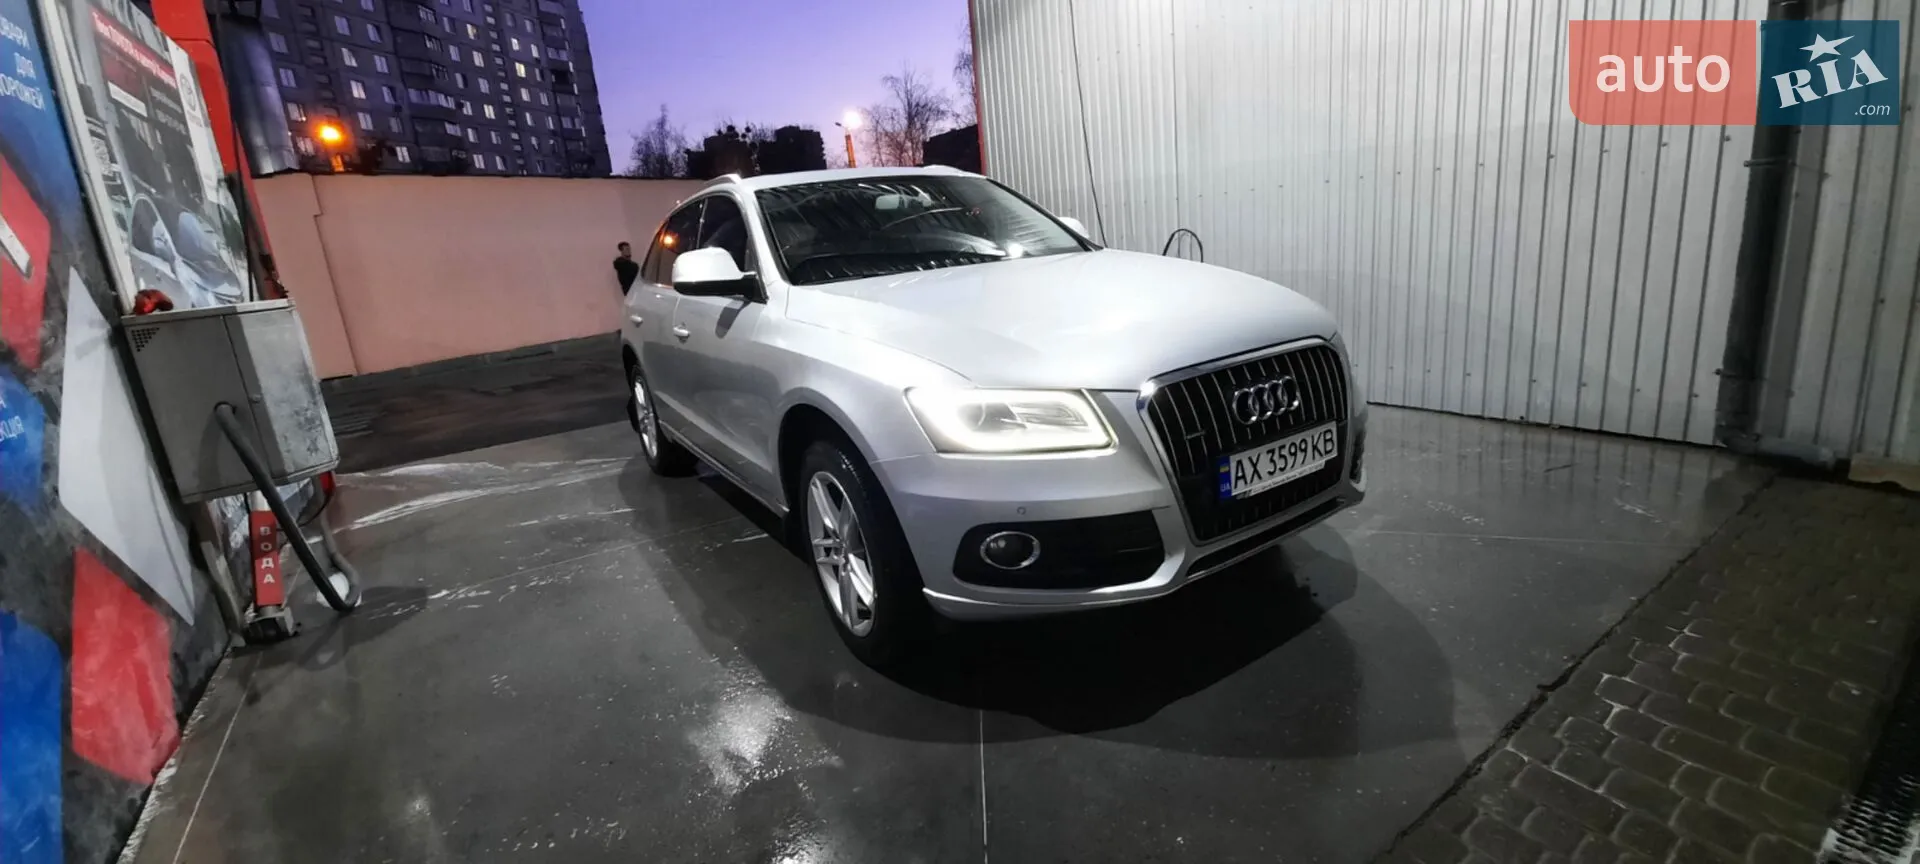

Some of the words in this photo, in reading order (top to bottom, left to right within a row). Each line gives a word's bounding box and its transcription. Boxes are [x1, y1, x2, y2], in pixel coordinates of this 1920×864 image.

[1220, 482, 1232, 493] UA
[1233, 452, 1263, 490] AX
[1266, 437, 1309, 476] 3599
[1311, 428, 1336, 461] KB
[259, 525, 276, 585] ВОДА
